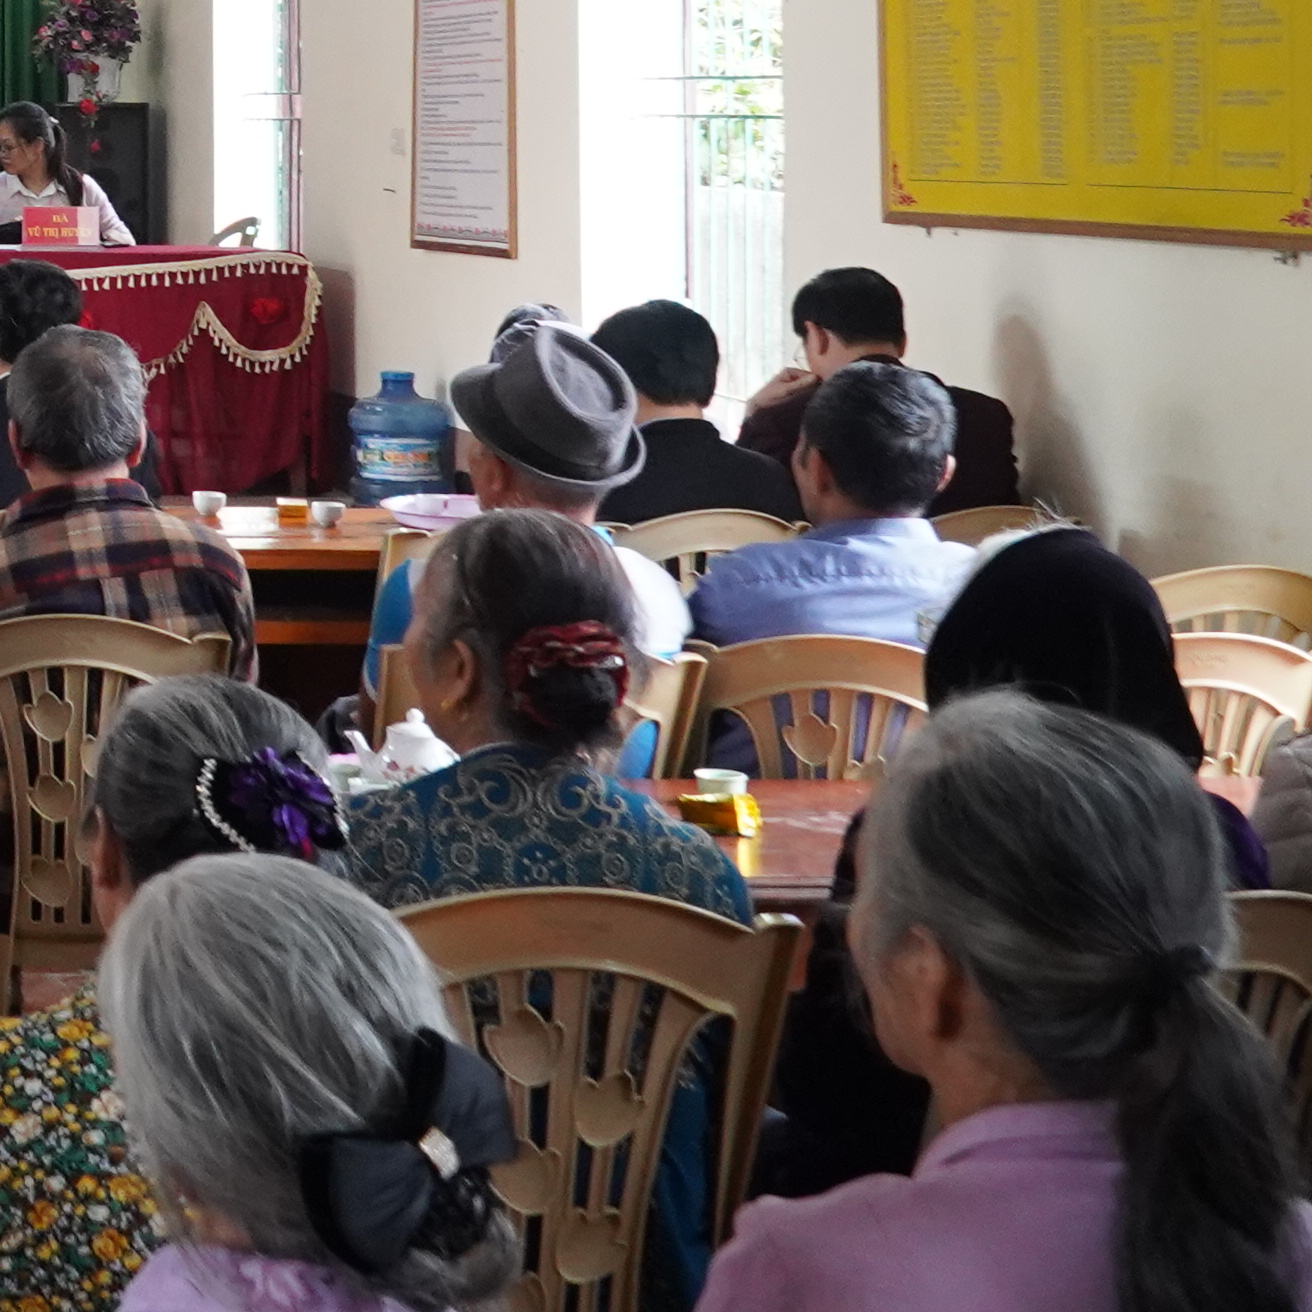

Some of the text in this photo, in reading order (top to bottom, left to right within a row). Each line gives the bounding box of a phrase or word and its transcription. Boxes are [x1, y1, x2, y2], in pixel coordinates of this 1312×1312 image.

[52, 213, 69, 223] BÀ
[27, 225, 41, 237] VŨ
[42, 227, 59, 239] THỊ
